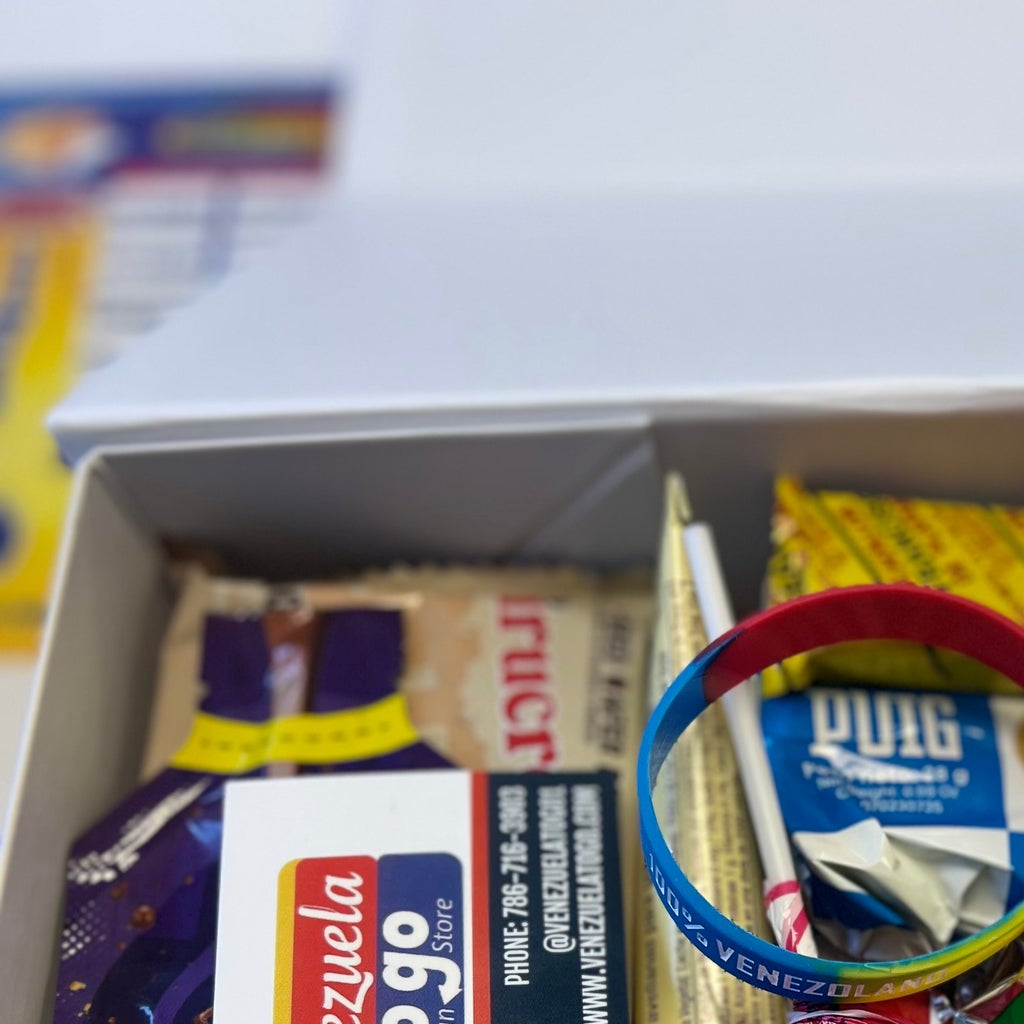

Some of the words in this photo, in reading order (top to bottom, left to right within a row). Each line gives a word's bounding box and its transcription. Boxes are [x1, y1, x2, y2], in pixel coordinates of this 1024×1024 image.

[810, 687, 965, 762] PUIG
[431, 897, 454, 954] Store
[648, 852, 708, 948] 100%
[382, 910, 462, 1000] go
[503, 921, 530, 987] PHONE:
